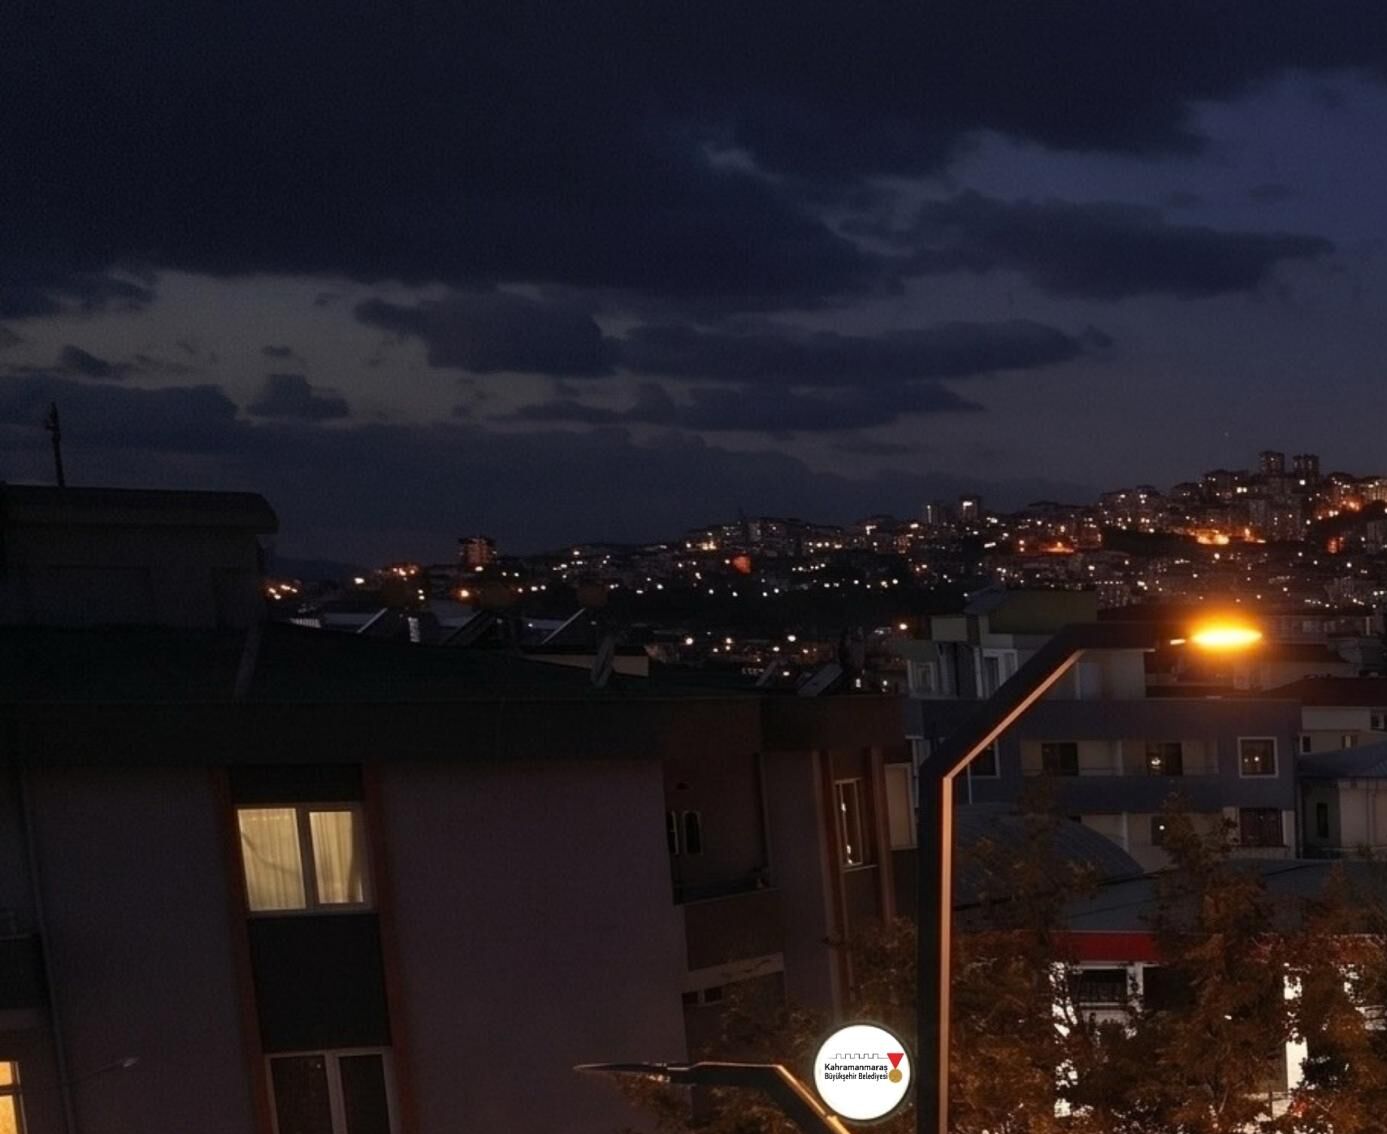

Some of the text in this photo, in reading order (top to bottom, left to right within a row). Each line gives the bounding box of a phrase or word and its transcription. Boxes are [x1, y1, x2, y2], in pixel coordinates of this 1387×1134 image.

[824, 1062, 888, 1073] Kahramanmaraş
[824, 1072, 888, 1082] Büyükşehir Belediyesi
